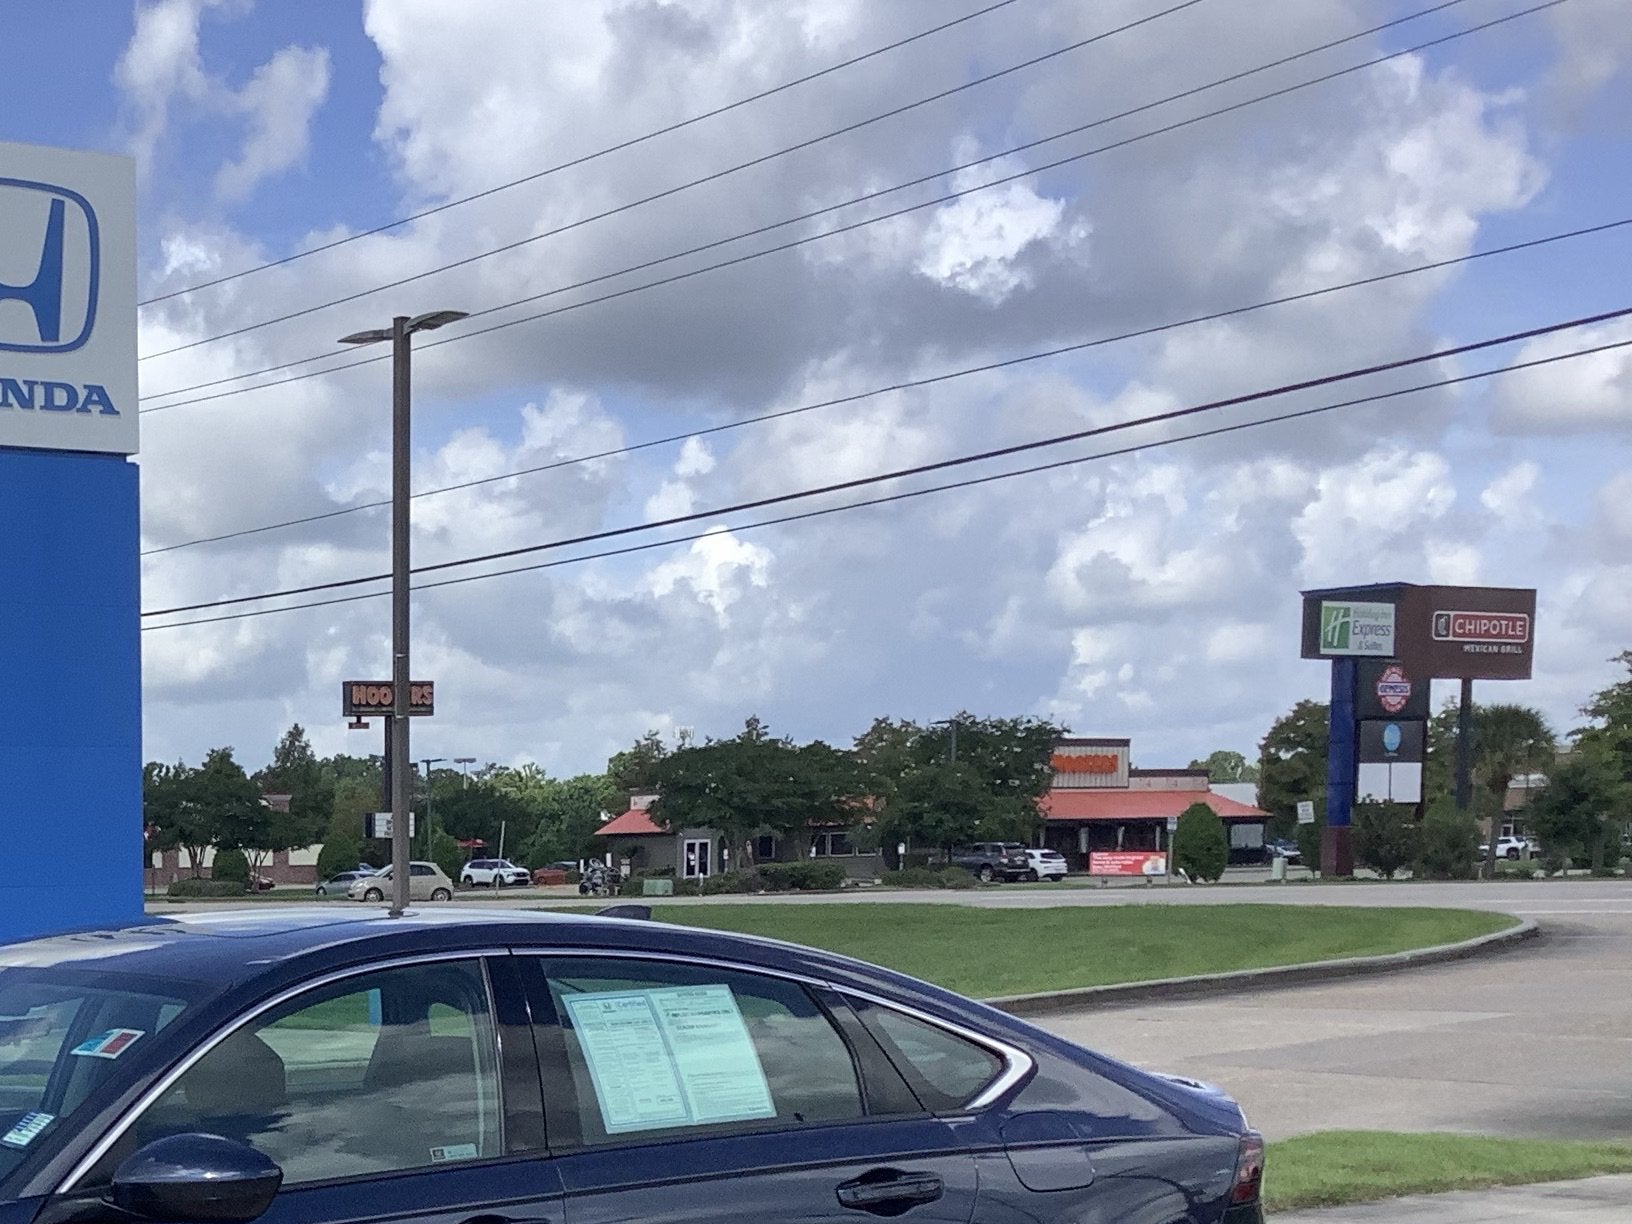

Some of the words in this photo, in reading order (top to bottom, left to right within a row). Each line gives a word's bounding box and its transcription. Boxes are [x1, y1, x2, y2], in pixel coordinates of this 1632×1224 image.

[1352, 620, 1392, 639] Express
[1455, 619, 1524, 635] CHIPOTLE
[1463, 644, 1499, 653] MEXICAN
[1500, 645, 1523, 654] GRILL
[352, 685, 433, 705] HOORS
